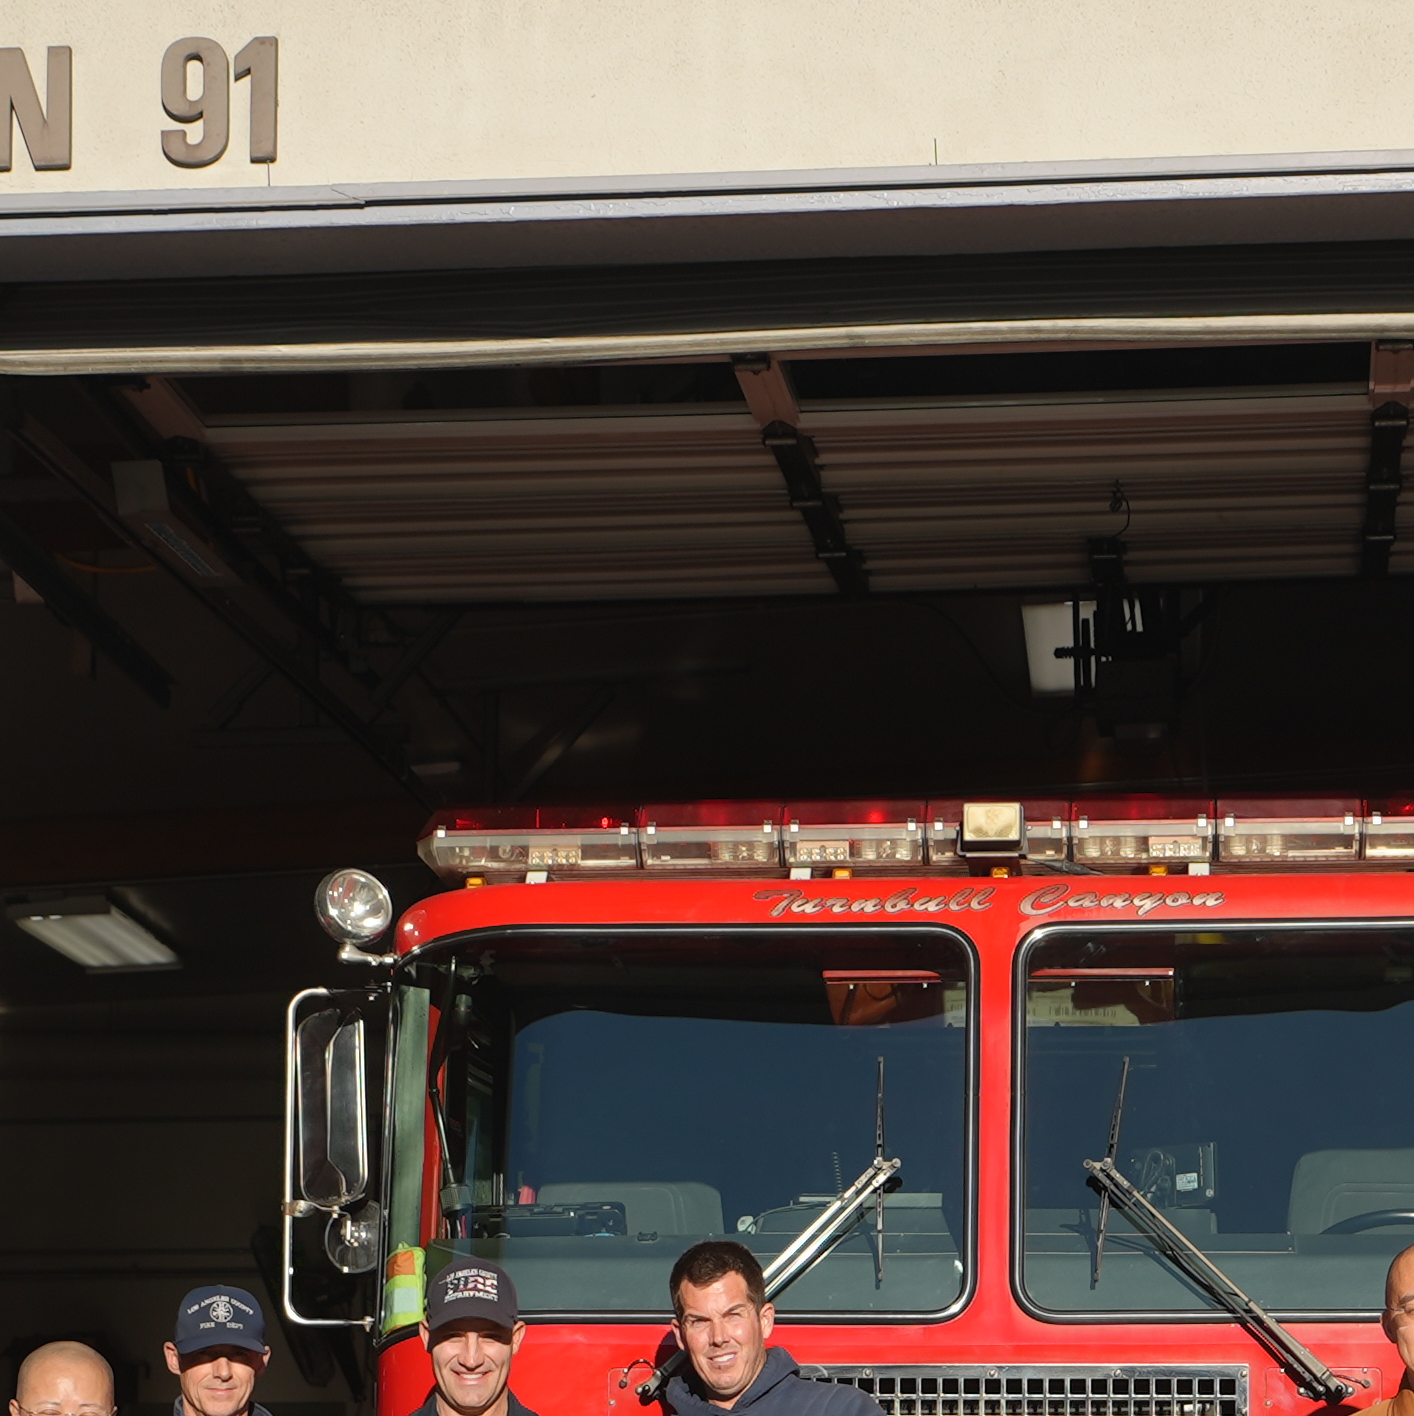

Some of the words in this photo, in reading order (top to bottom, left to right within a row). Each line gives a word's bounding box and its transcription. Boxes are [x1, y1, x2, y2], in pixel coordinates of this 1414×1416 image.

[160, 35, 280, 169] 91
[753, 886, 995, 917] Turnbull
[1018, 883, 1224, 917] Canyon
